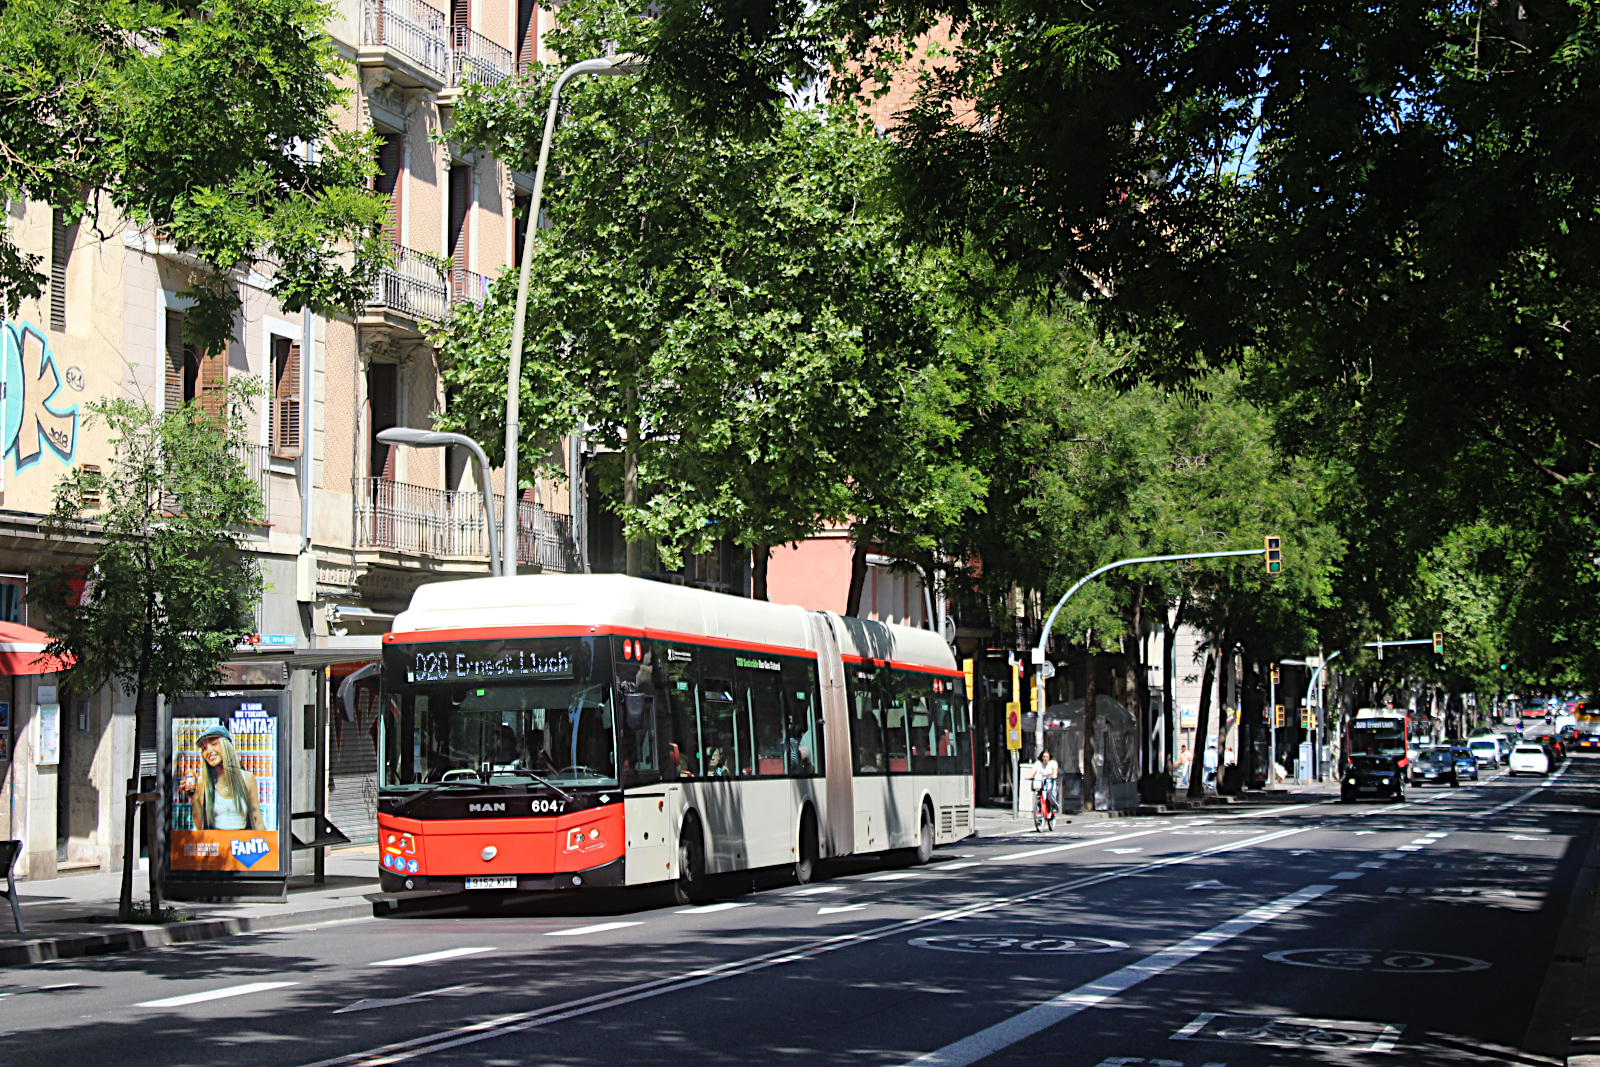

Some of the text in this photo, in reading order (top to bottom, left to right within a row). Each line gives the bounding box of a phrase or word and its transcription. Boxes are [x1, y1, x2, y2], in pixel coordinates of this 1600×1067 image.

[455, 653, 514, 677] Ernest
[519, 650, 569, 673] Lluch
[469, 802, 506, 812] MAN
[531, 799, 566, 813] 6047
[230, 837, 270, 856] FANTA
[472, 877, 514, 888] 9152 KPT
[1317, 952, 1436, 968] 30
